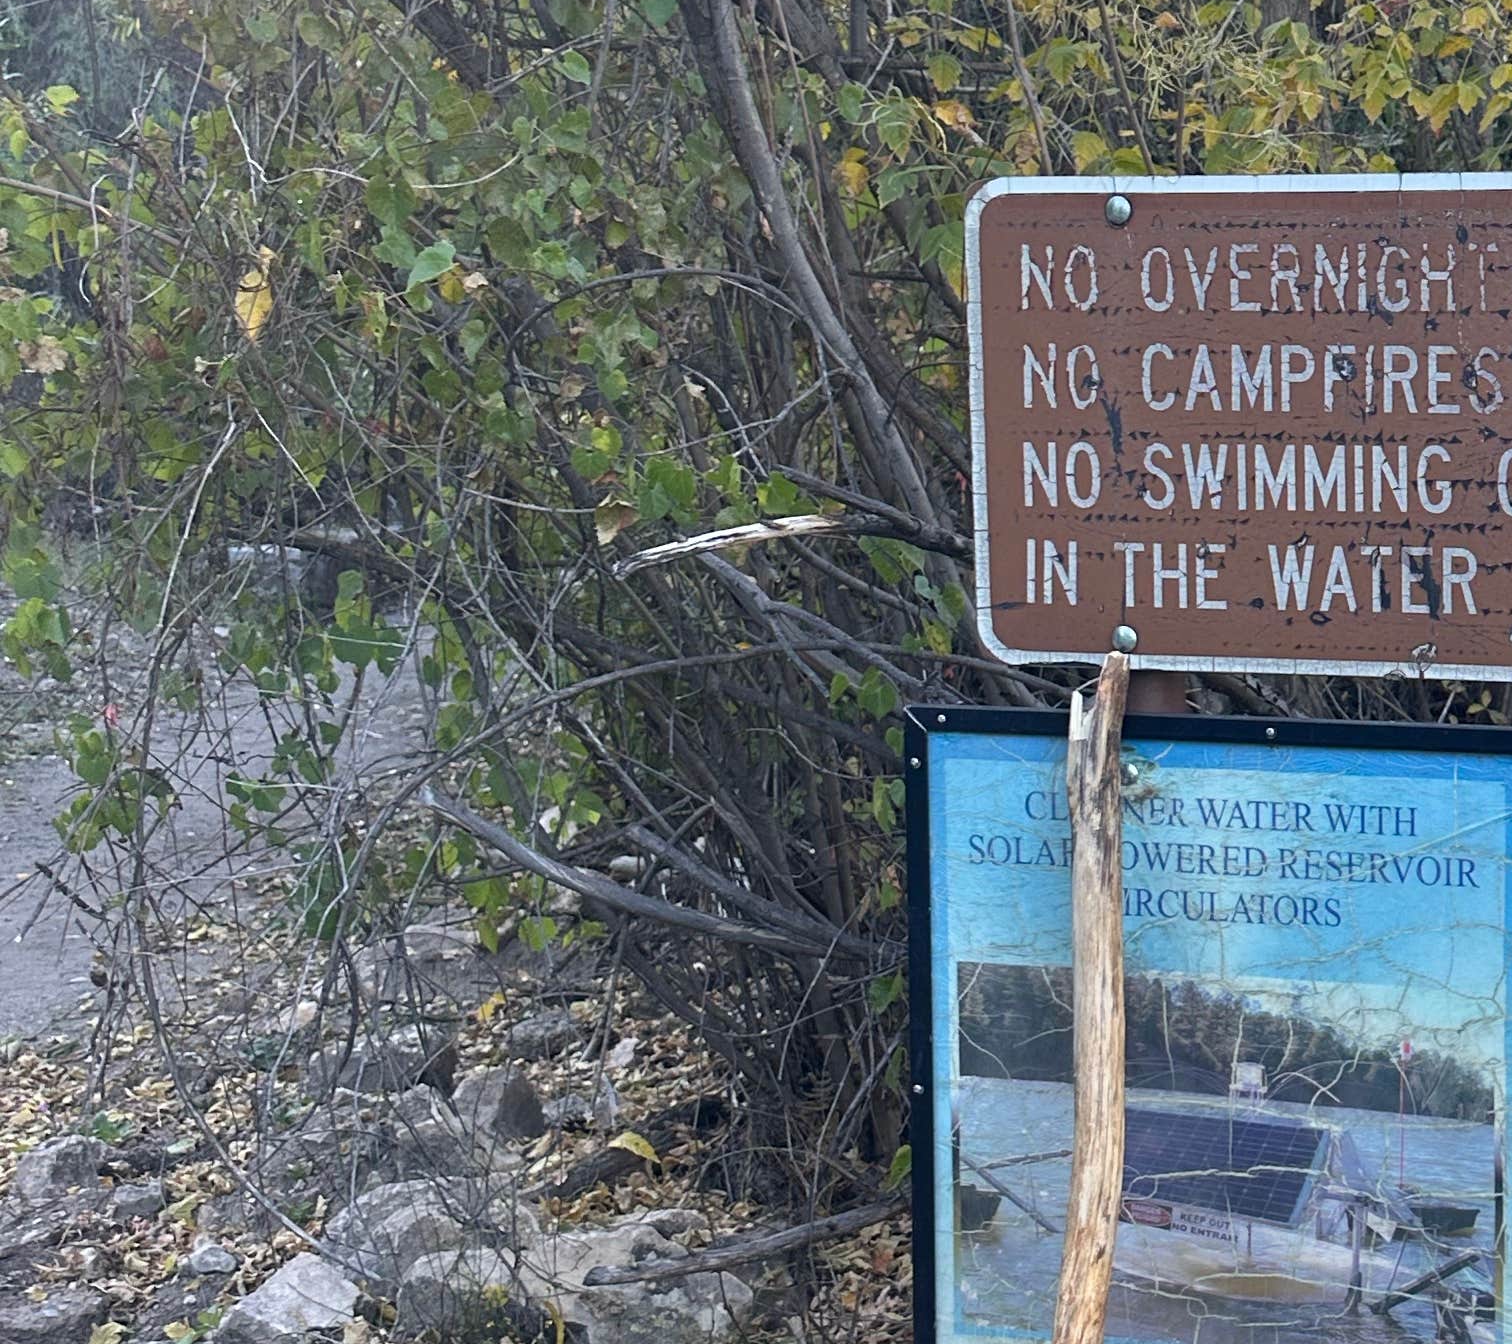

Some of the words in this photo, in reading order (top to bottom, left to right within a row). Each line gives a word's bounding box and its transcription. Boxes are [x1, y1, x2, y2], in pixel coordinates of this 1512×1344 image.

[1020, 243, 1098, 311] NO
[1140, 242, 1498, 313] OVERNIGHT
[1022, 342, 1099, 410] NO
[1141, 342, 1503, 414] CAMPFIRES
[1022, 441, 1101, 509] NO
[1142, 442, 1453, 514] SWIMMING
[1026, 538, 1078, 606] IN
[1114, 542, 1228, 610] THE
[1268, 543, 1478, 615] WATER
[1025, 790, 1188, 828] CLNER
[1197, 798, 1316, 832] WATER
[1323, 803, 1418, 837] WITH
[1122, 840, 1267, 877] OWERED
[1278, 848, 1480, 888] RESERVOIR
[1123, 887, 1342, 927] IRCULATORS
